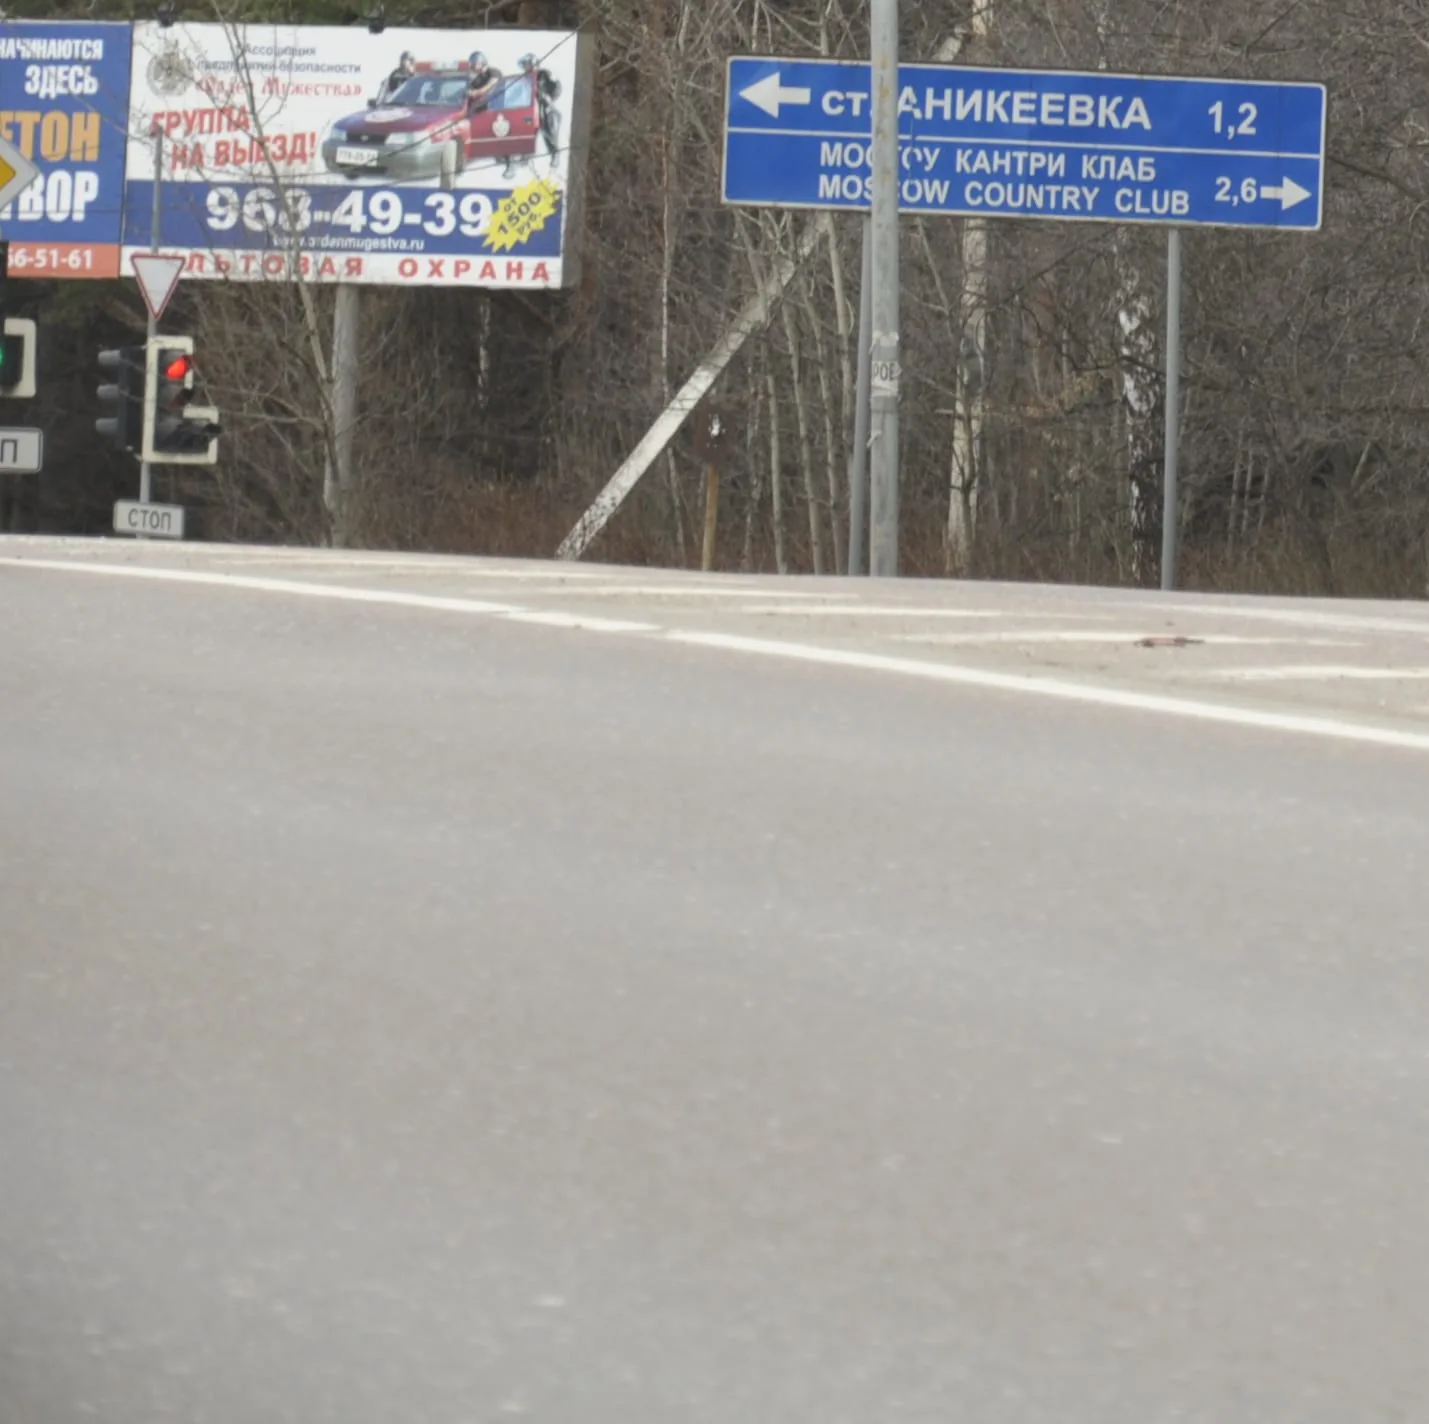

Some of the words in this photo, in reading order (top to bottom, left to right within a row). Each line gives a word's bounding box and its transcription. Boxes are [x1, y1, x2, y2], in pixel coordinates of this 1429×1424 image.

[25, 65, 98, 99] ЗДЕСЬ
[150, 103, 251, 138] ГРУППА
[897, 85, 1152, 131] АНИКЕЕВКА
[1207, 101, 1258, 138] 1,2
[171, 142, 204, 170] НА
[214, 131, 317, 167] ВЫЕЗД!
[819, 141, 940, 172] МООУ
[955, 148, 1066, 177] КАНТРИ
[1081, 154, 1156, 182] КЛАБ
[0, 170, 100, 222] ВОР
[497, 192, 541, 235] 1500
[818, 174, 950, 205] MOOW
[964, 180, 1099, 211] COUNTRY
[1115, 188, 1189, 215] CLUB
[1214, 177, 1258, 207] 2,6
[133, 253, 363, 277] ЛЬТОВАЯ
[398, 258, 550, 281] ОХРАНА
[128, 508, 172, 531] СТОП
